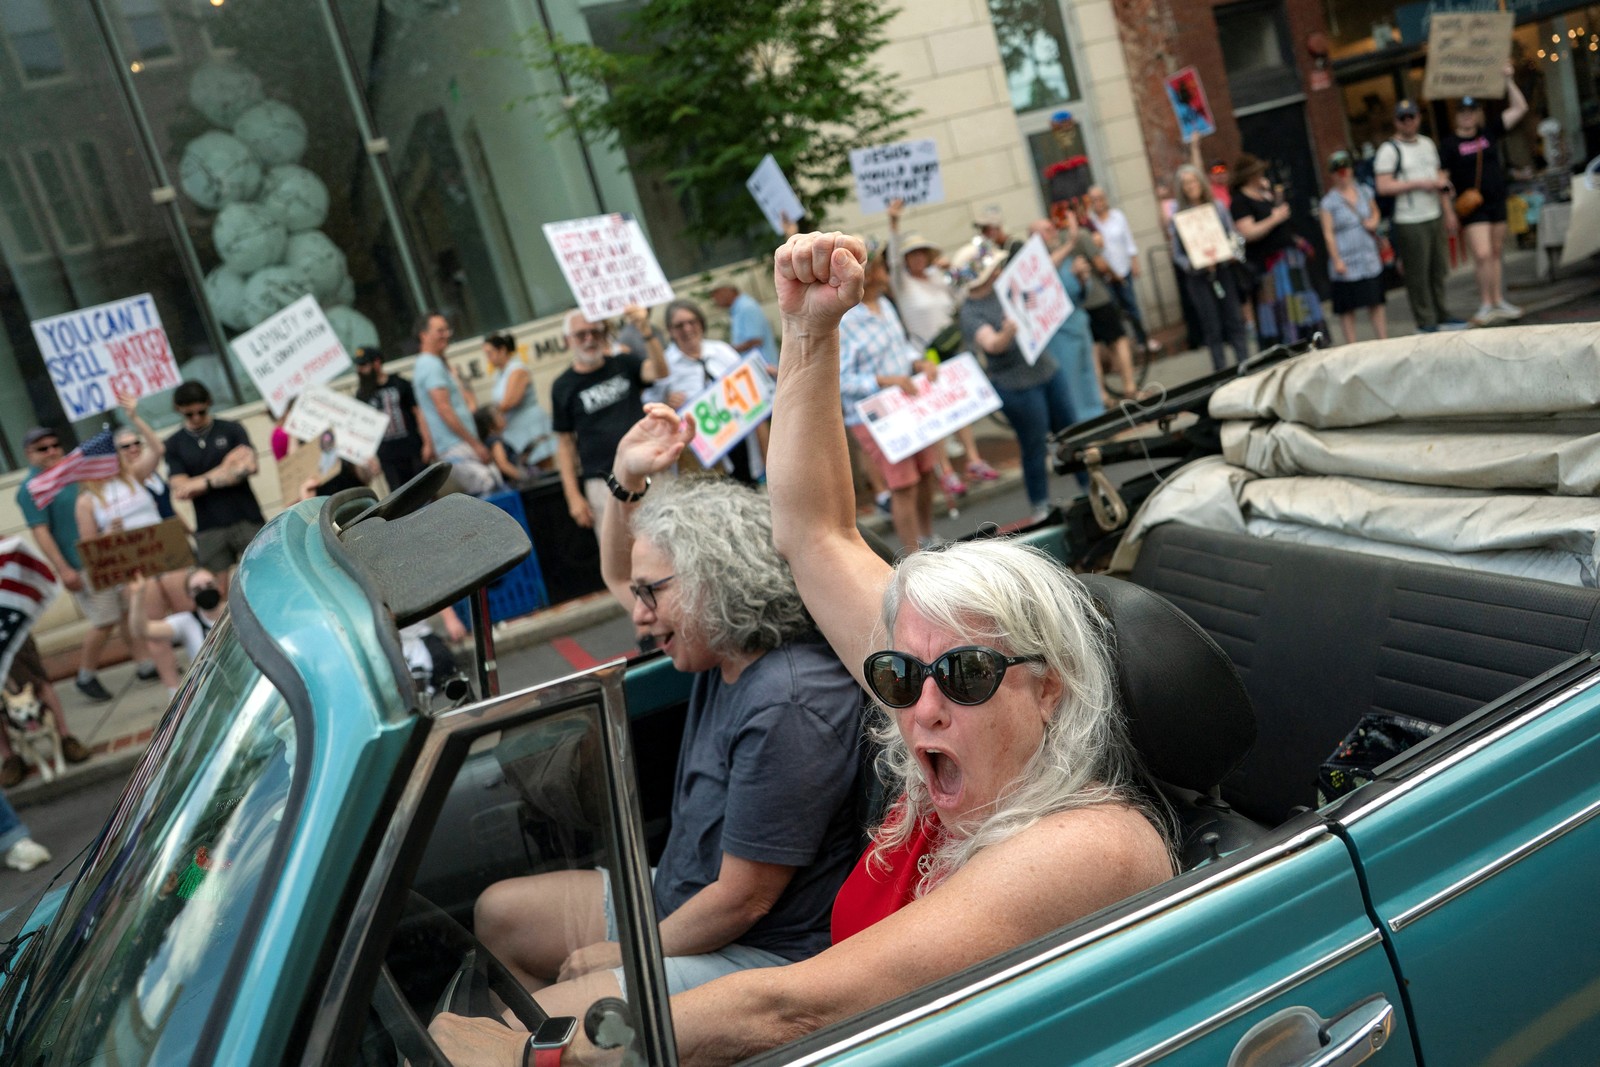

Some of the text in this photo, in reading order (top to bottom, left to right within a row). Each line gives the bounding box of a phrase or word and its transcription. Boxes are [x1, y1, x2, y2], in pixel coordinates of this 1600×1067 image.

[41, 314, 96, 354] YOU
[47, 347, 107, 387] SPELL
[63, 381, 106, 415] W/O
[693, 390, 733, 437] 86
[721, 362, 763, 414] 47
